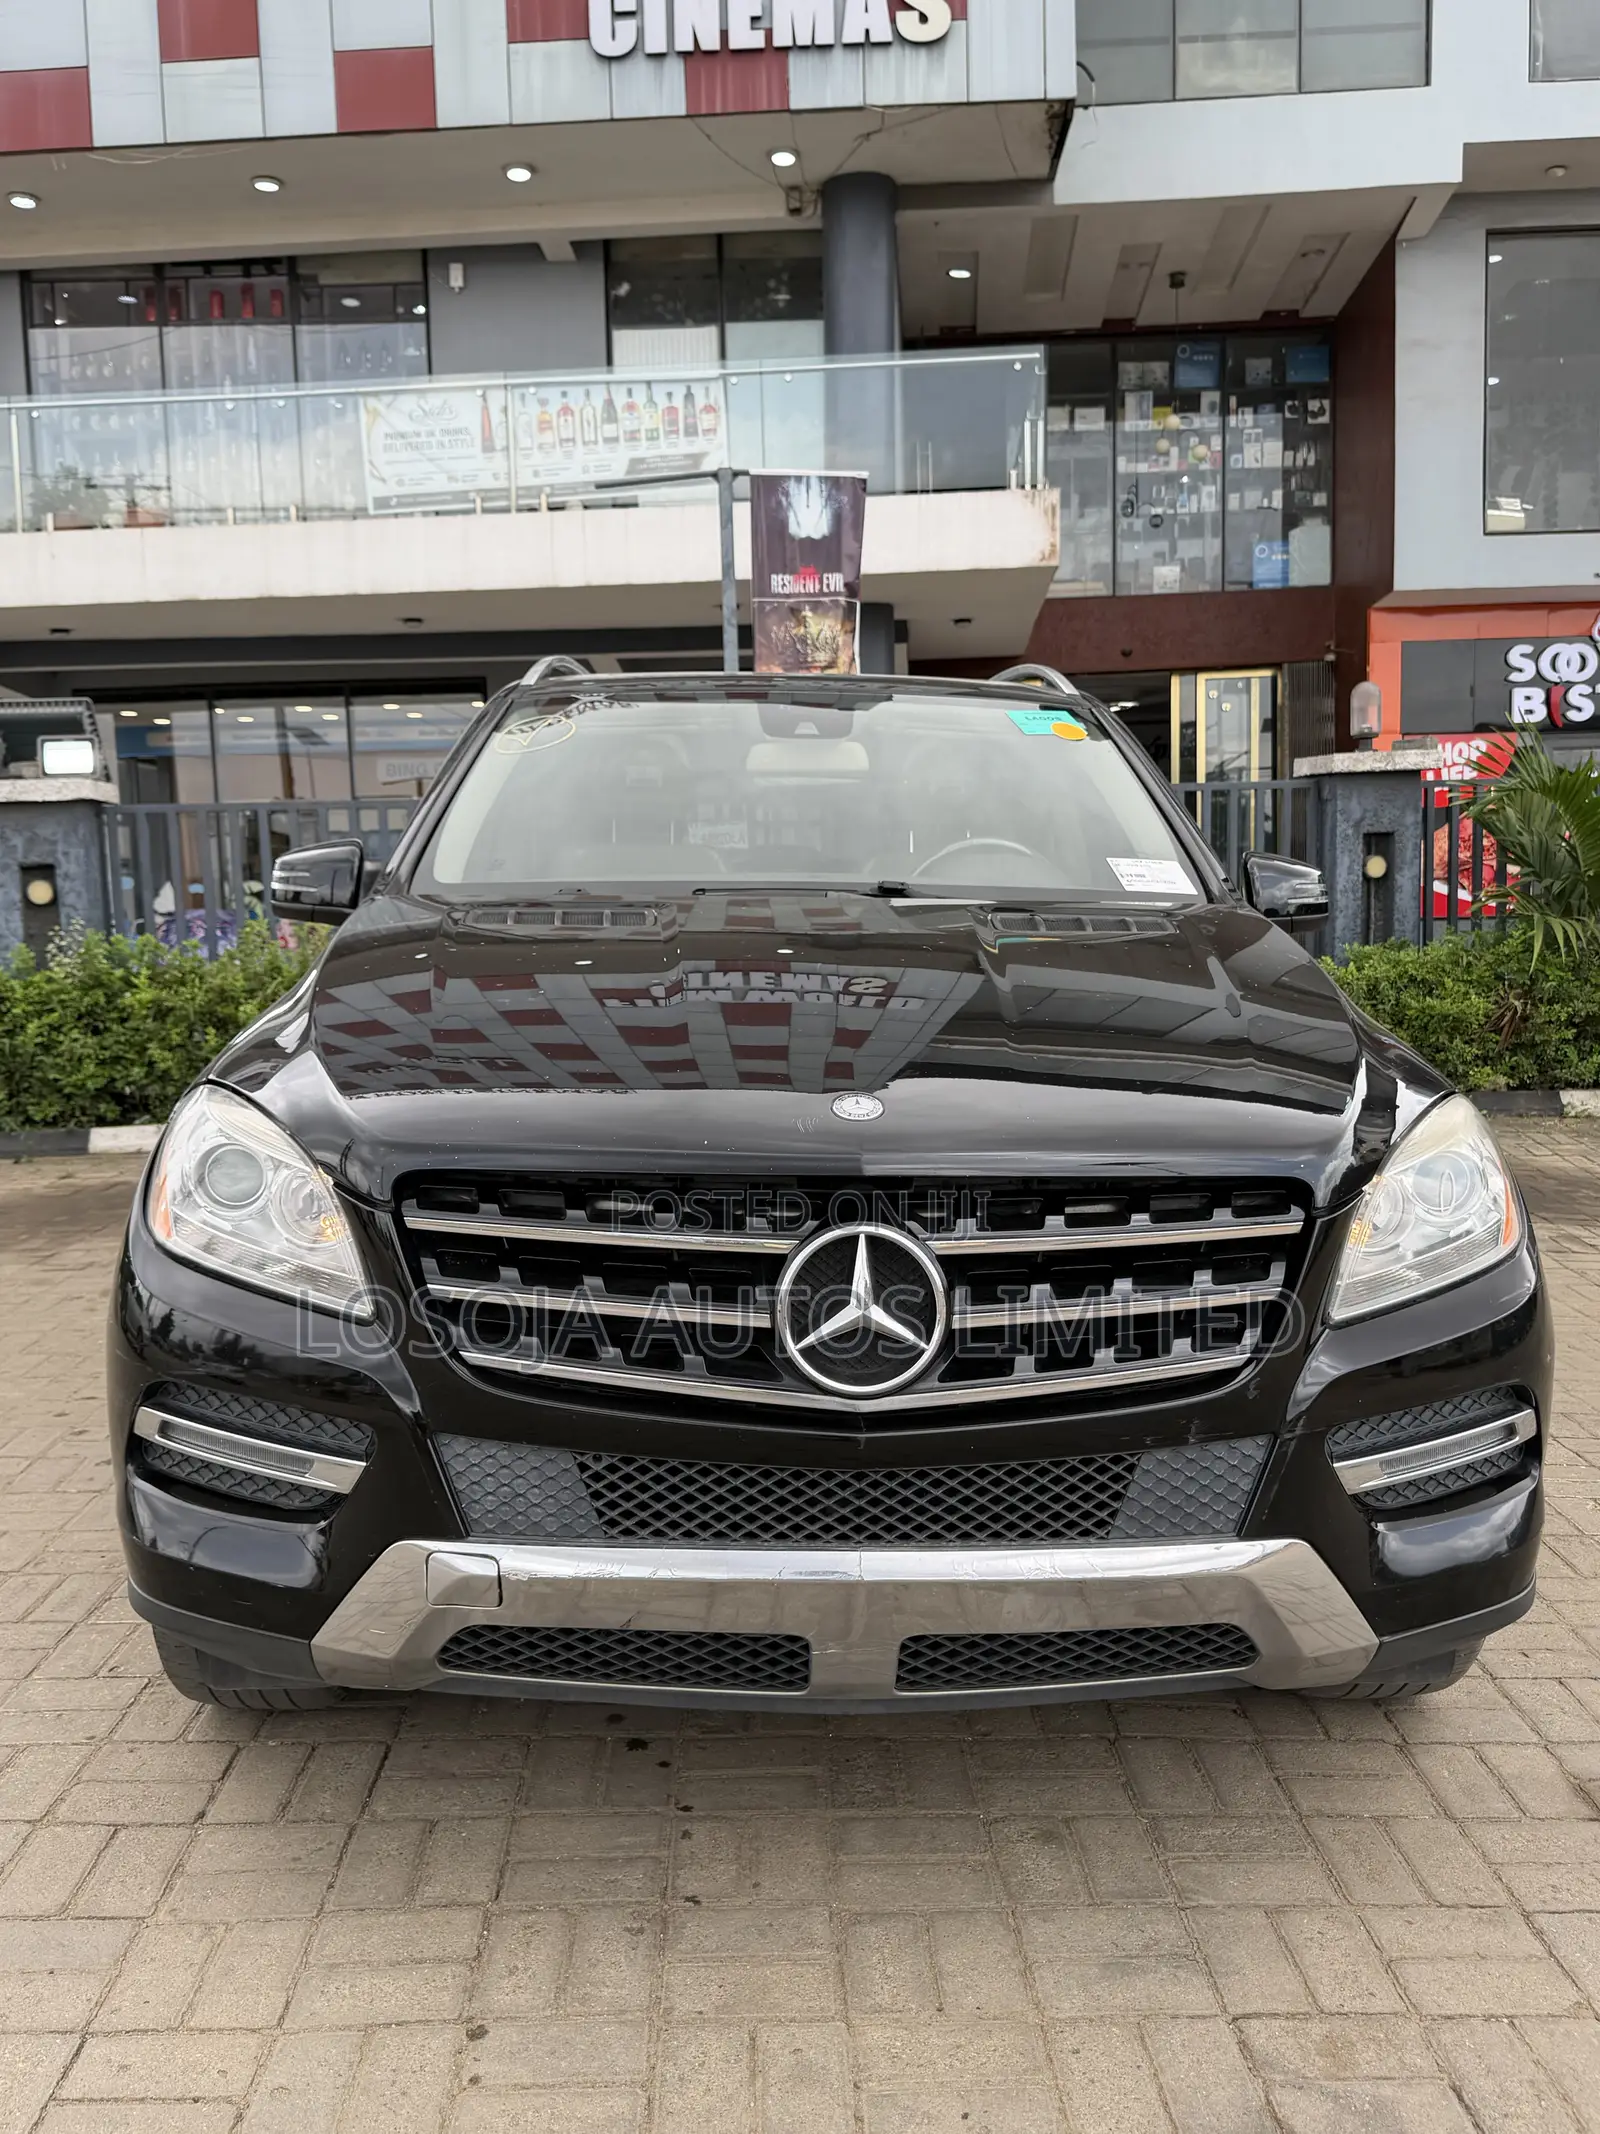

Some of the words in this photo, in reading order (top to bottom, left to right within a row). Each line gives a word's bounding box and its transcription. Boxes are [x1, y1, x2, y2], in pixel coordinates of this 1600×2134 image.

[588, 0, 951, 57] CINEMAS
[771, 574, 821, 594] RESIDENT
[823, 573, 844, 592] EVIL
[1506, 643, 1600, 682] SOO
[1437, 740, 1487, 766] HOP
